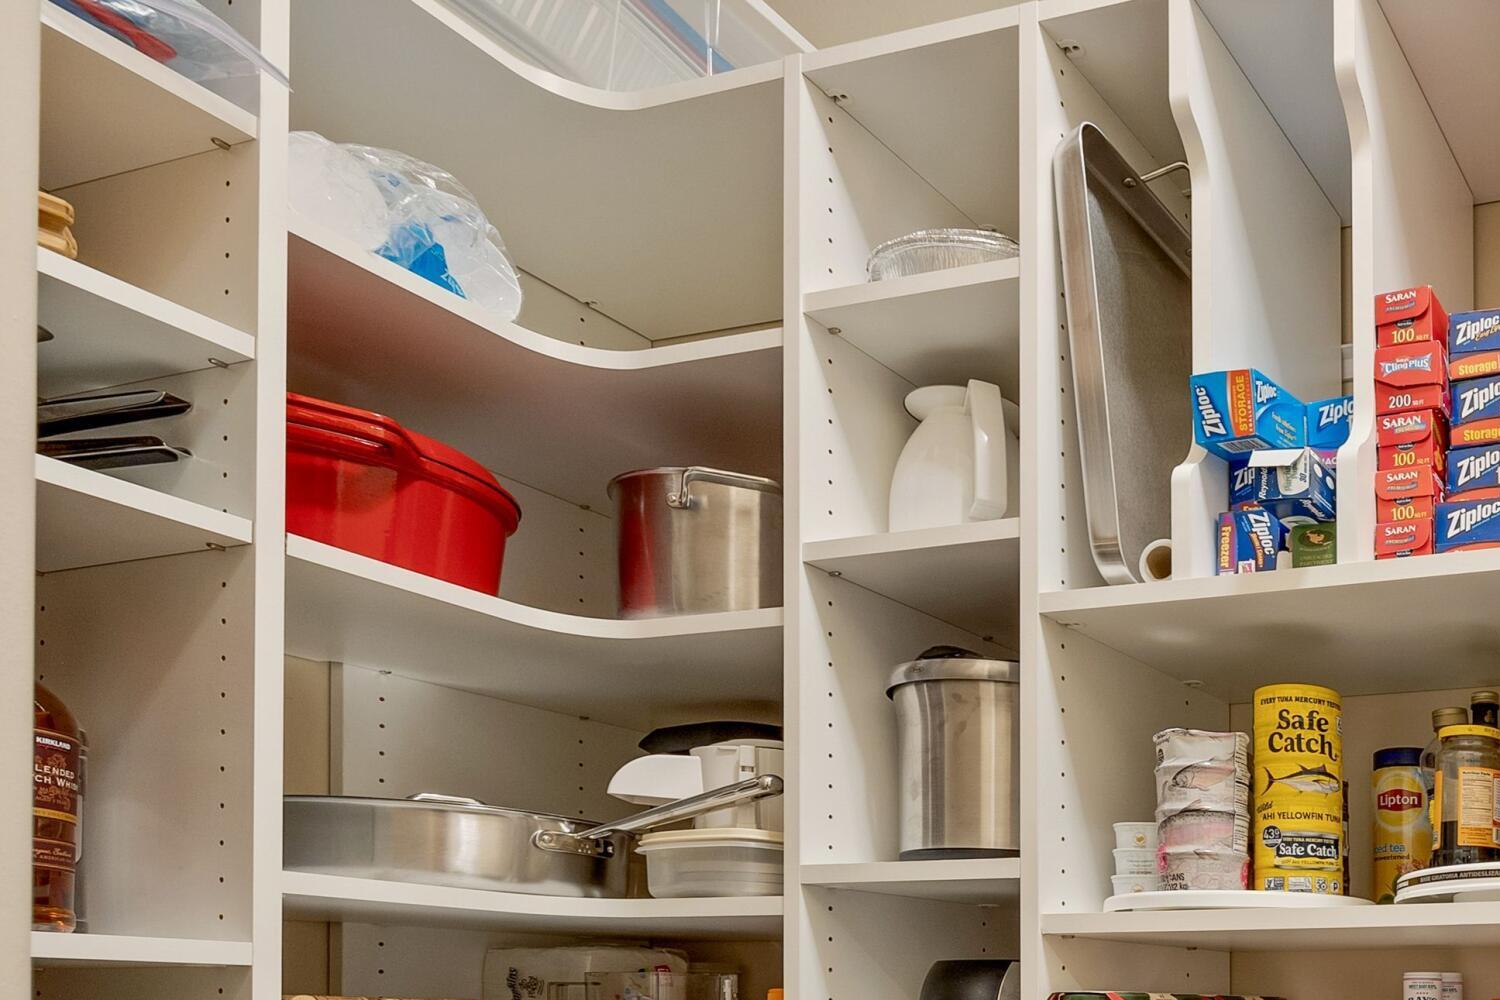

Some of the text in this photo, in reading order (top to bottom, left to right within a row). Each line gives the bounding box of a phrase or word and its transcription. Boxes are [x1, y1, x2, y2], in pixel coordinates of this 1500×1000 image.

[1385, 290, 1417, 304] SARAN
[1391, 328, 1415, 343] 100
[1456, 314, 1500, 346] Ziploc
[1458, 356, 1498, 376] Storage
[1236, 375, 1248, 433] STORAGE
[1388, 393, 1411, 408] 200
[1196, 386, 1227, 438] Ziploc
[1383, 414, 1421, 431] SARAN
[1393, 452, 1415, 466] 100
[1386, 471, 1418, 482] SARAN
[1391, 505, 1414, 520] 100
[1248, 511, 1275, 558] Ziploc
[1384, 525, 1417, 536] SARAN
[1221, 526, 1232, 568] Freezer
[1294, 696, 1326, 706] MERCURY
[1276, 708, 1329, 733] Safe
[1268, 732, 1338, 762] Catch
[1379, 795, 1418, 808] Lipton
[1263, 811, 1324, 822] AHI YELLOWFIN
[1279, 842, 1337, 858] Safe Catch
